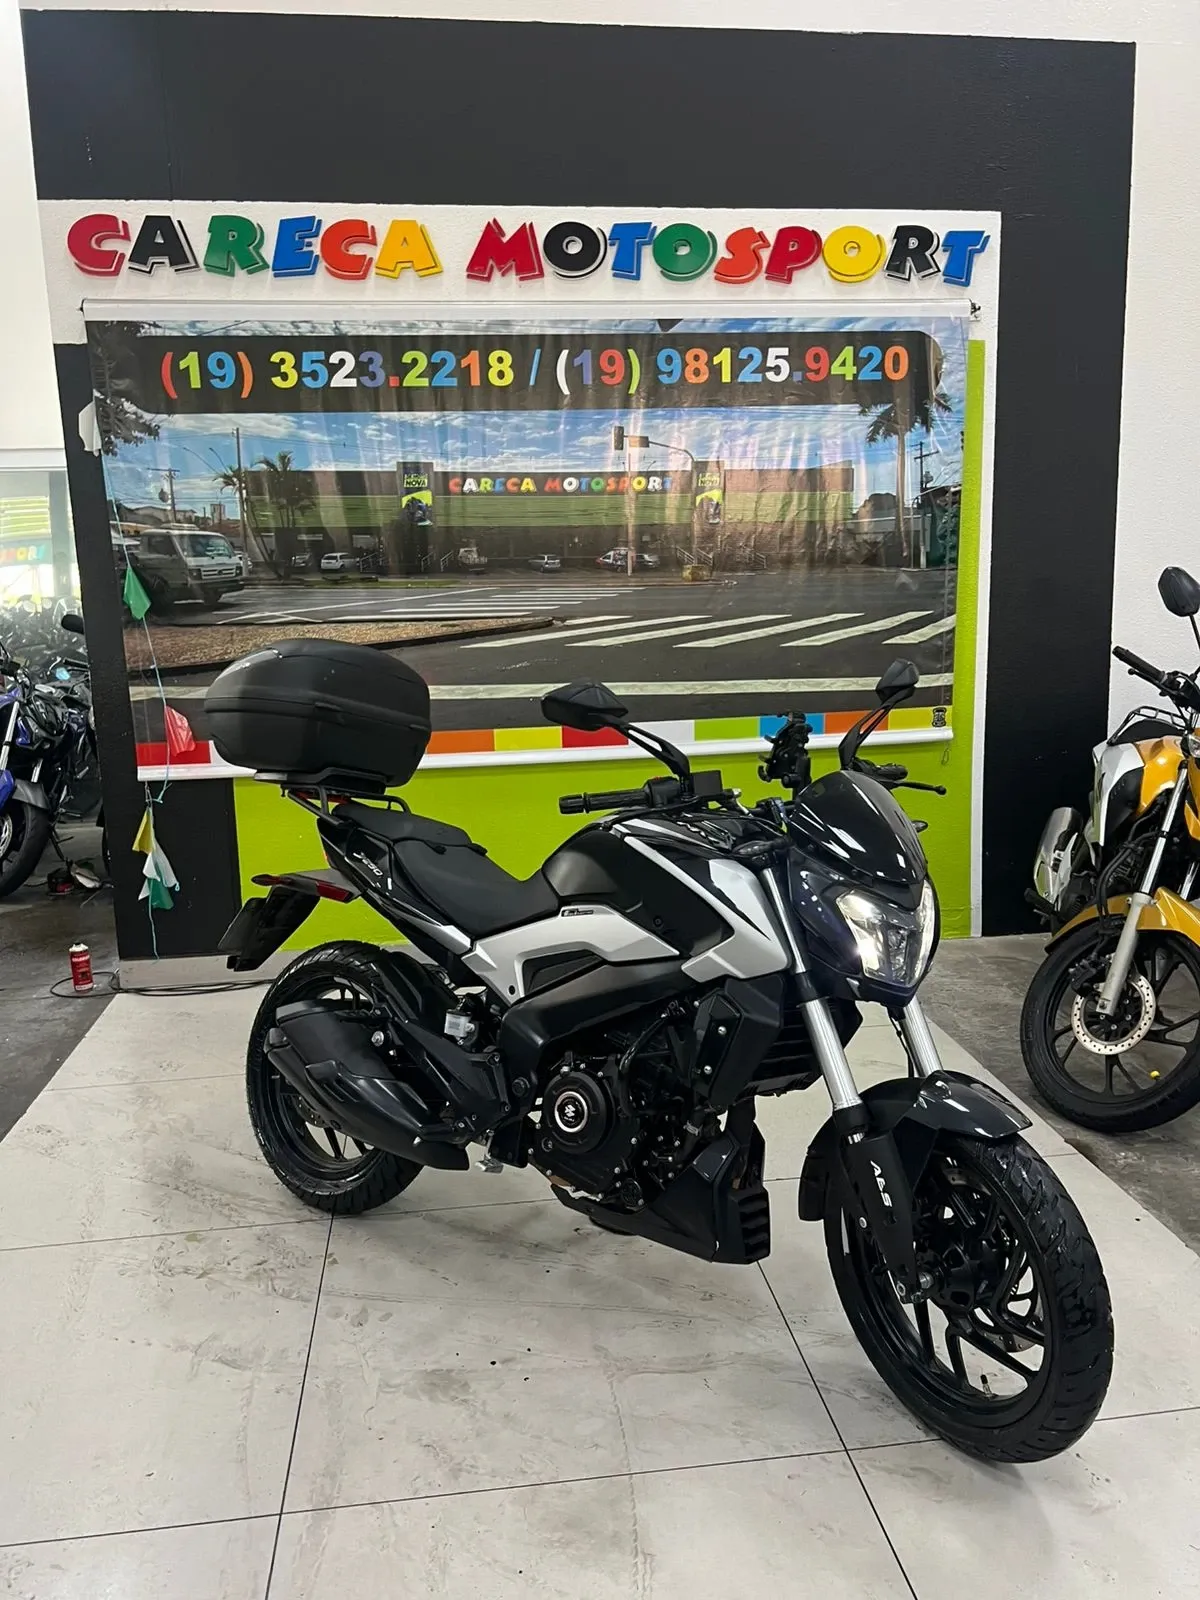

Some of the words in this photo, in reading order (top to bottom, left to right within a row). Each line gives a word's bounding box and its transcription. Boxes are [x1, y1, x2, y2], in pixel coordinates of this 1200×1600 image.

[67, 213, 443, 281] CARECA
[465, 217, 990, 287] MOTOSPORT
[161, 351, 253, 399] (19)
[270, 350, 514, 389] 3523.2218
[529, 348, 542, 386] /
[556, 348, 640, 395] (19)
[656, 345, 909, 384] 98125.9420
[448, 477, 537, 493] CARECA
[544, 477, 673, 493] MOTOSPORT
